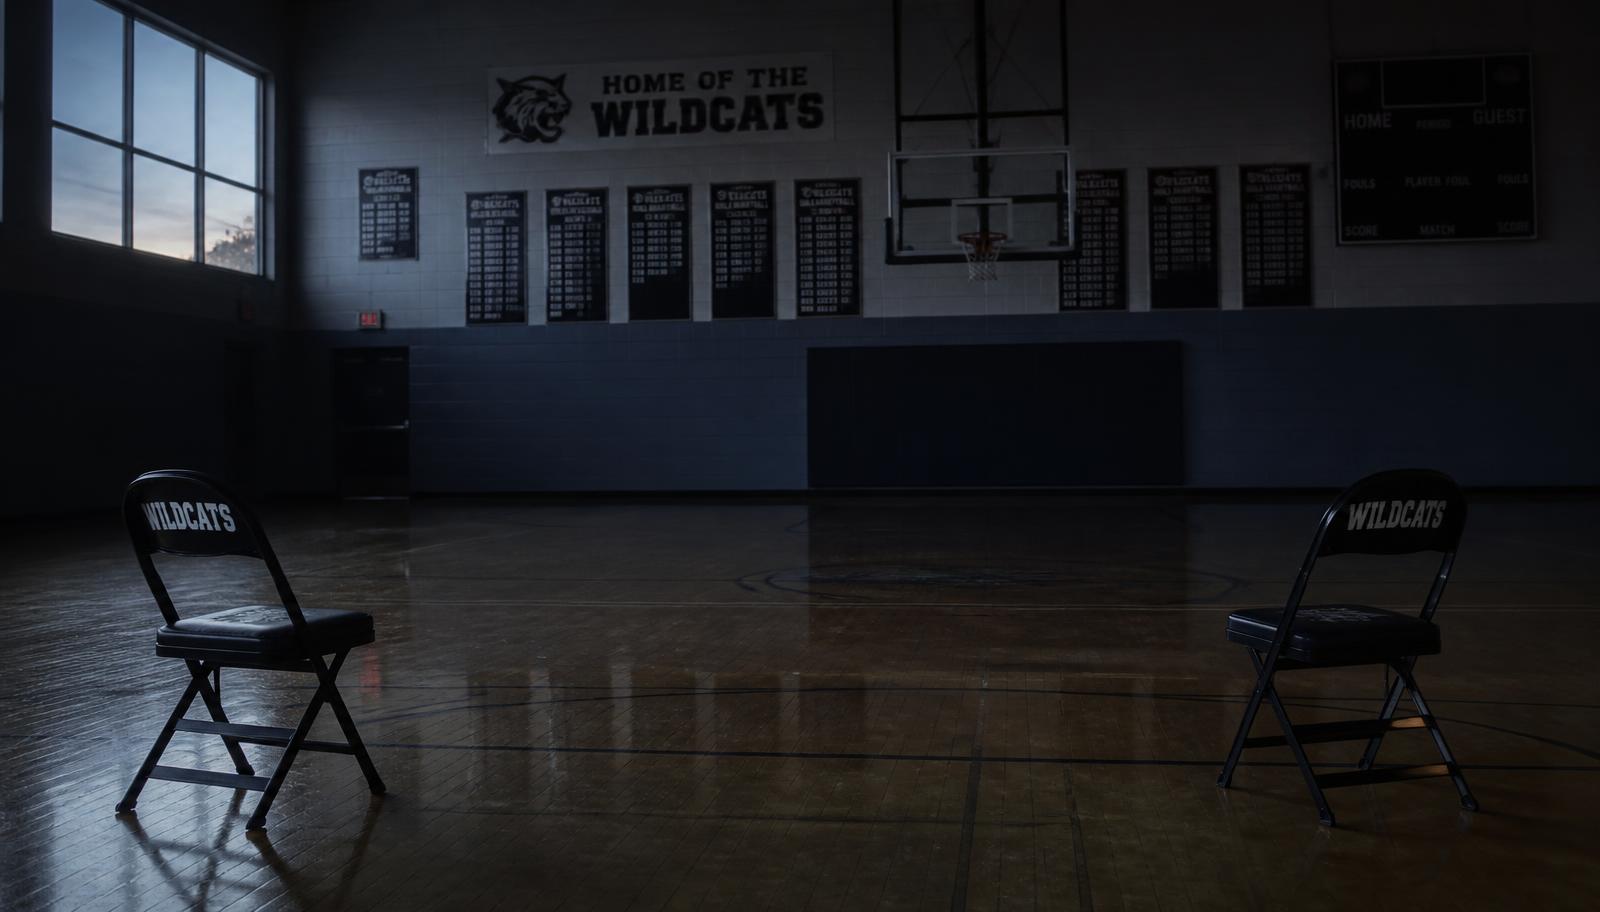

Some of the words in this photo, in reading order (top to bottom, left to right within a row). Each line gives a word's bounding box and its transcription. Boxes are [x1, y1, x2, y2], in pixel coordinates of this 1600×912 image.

[602, 72, 685, 95] HOME
[698, 69, 734, 91] OF
[747, 66, 809, 89] THE
[590, 92, 824, 138] WILDCATS
[1344, 111, 1392, 129] HOME
[1473, 108, 1528, 126] GUEST
[141, 501, 237, 533] WILDCATS
[1346, 499, 1447, 531] WILDCATS
